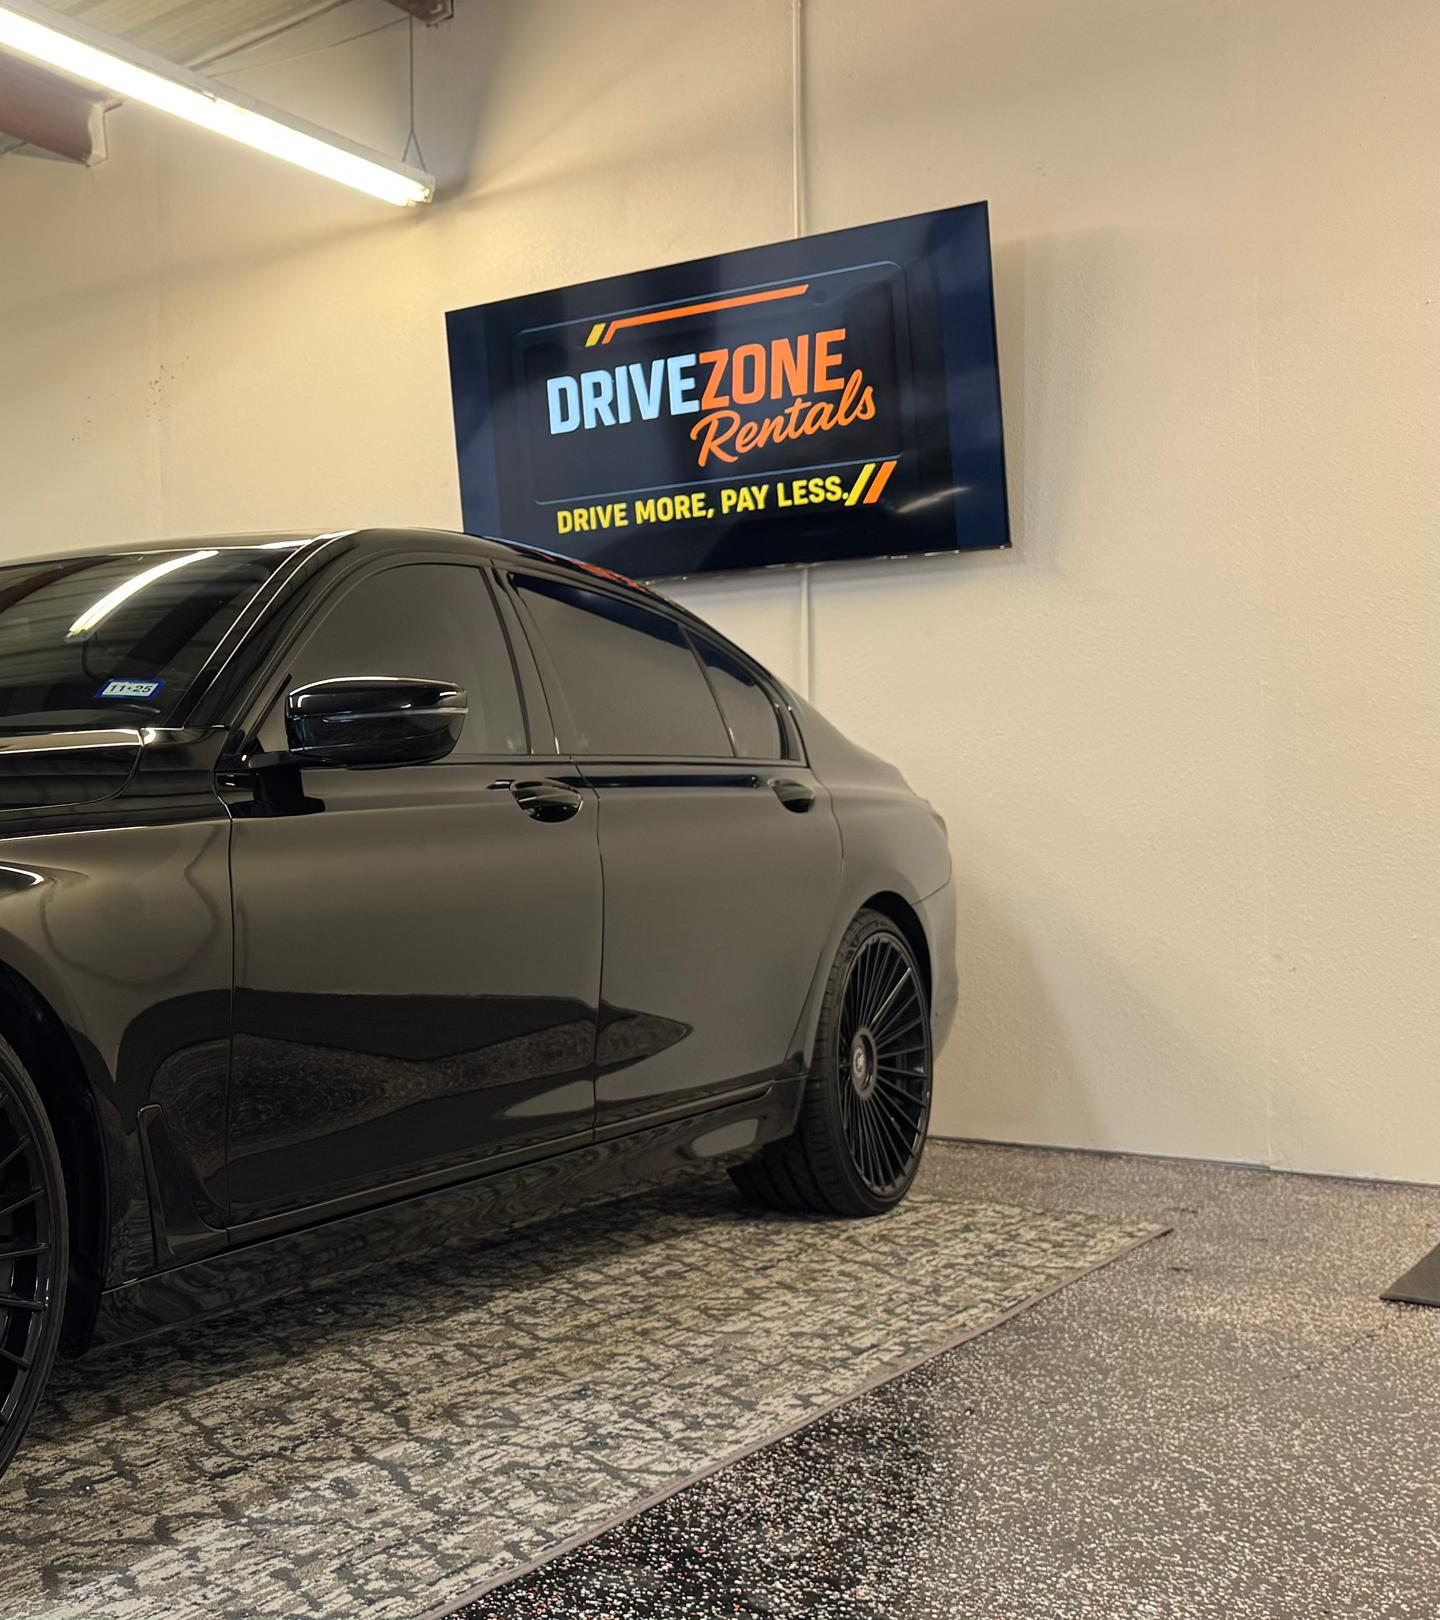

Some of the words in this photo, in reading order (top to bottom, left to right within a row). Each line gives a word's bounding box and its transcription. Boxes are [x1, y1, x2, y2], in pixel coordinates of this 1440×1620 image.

[689, 368, 877, 467] Rentals
[556, 501, 627, 534] DRIVE
[635, 492, 715, 526] MORE,
[721, 487, 767, 515] PAY
[777, 475, 848, 508] LESS.
